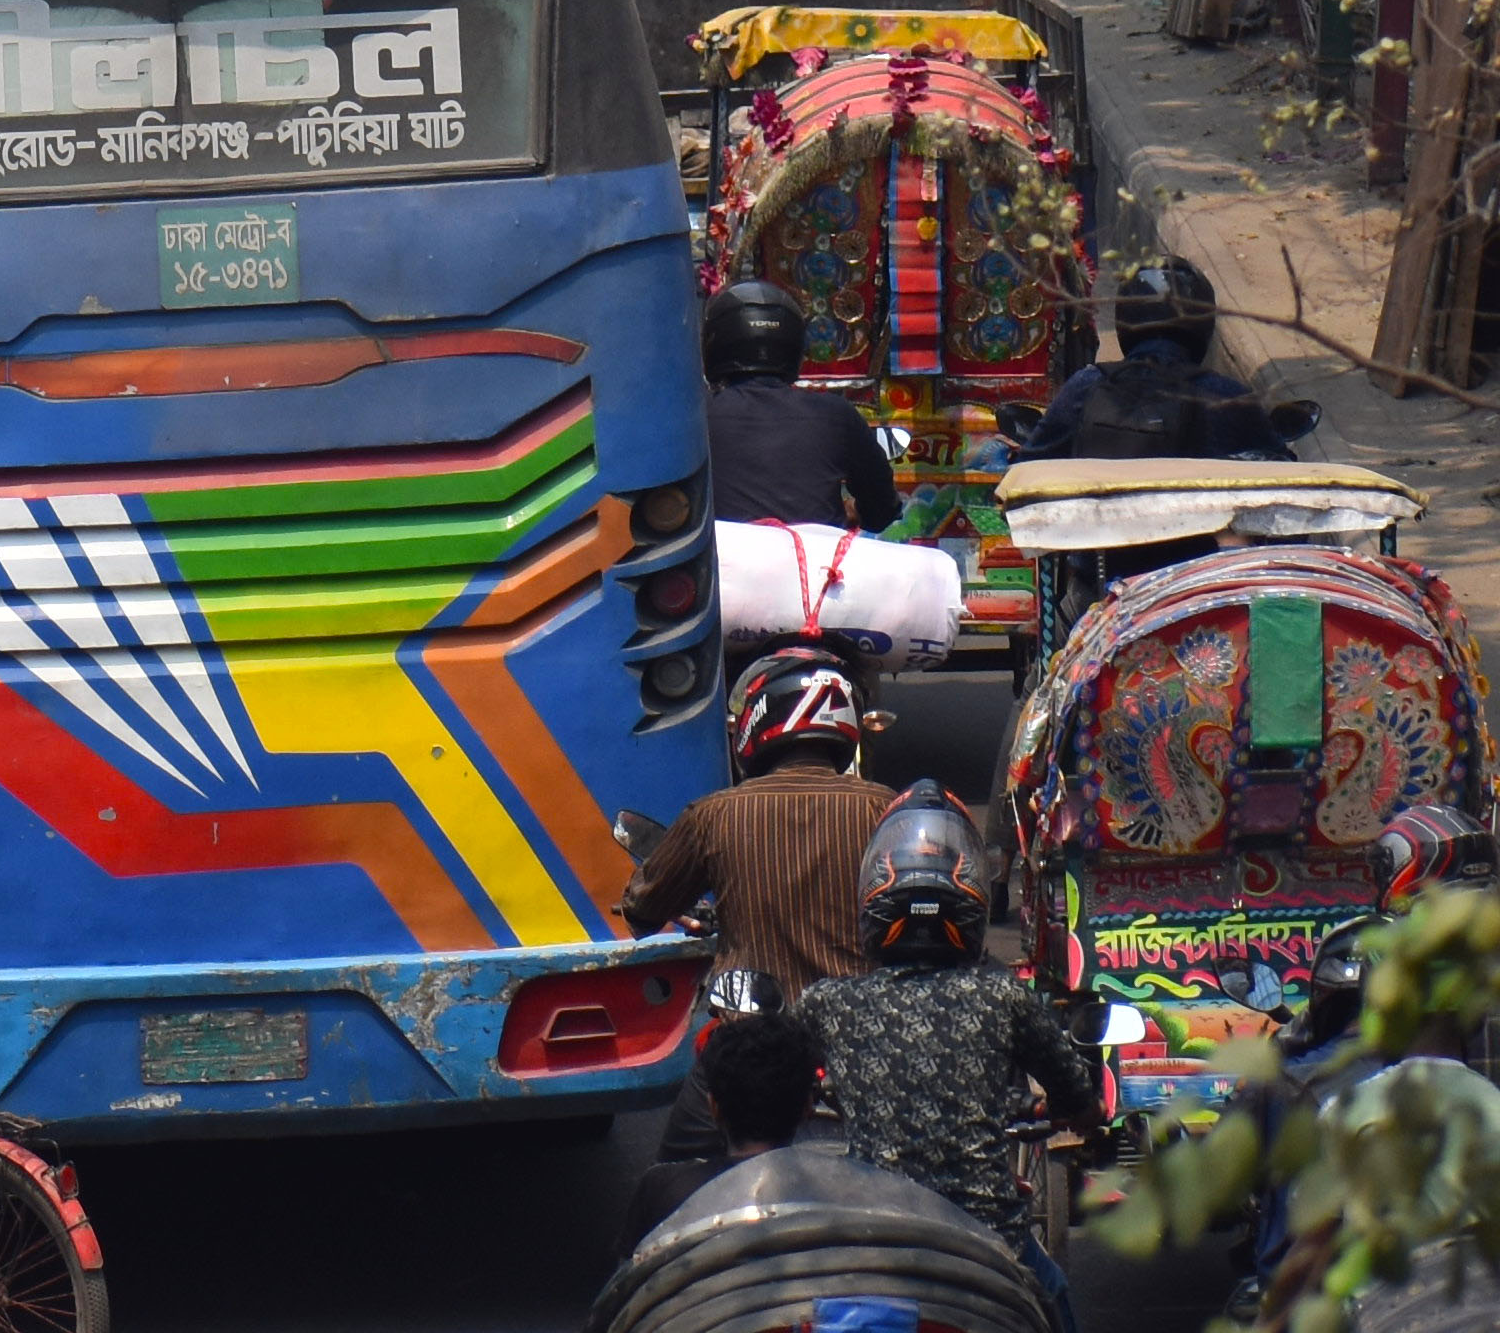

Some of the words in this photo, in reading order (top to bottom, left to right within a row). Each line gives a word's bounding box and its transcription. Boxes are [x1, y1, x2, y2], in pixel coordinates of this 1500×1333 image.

[409, 99, 467, 151] ঘাট
[161, 220, 208, 253] ঢাকা
[174, 259, 290, 295] ১৫-৩৪৭১
